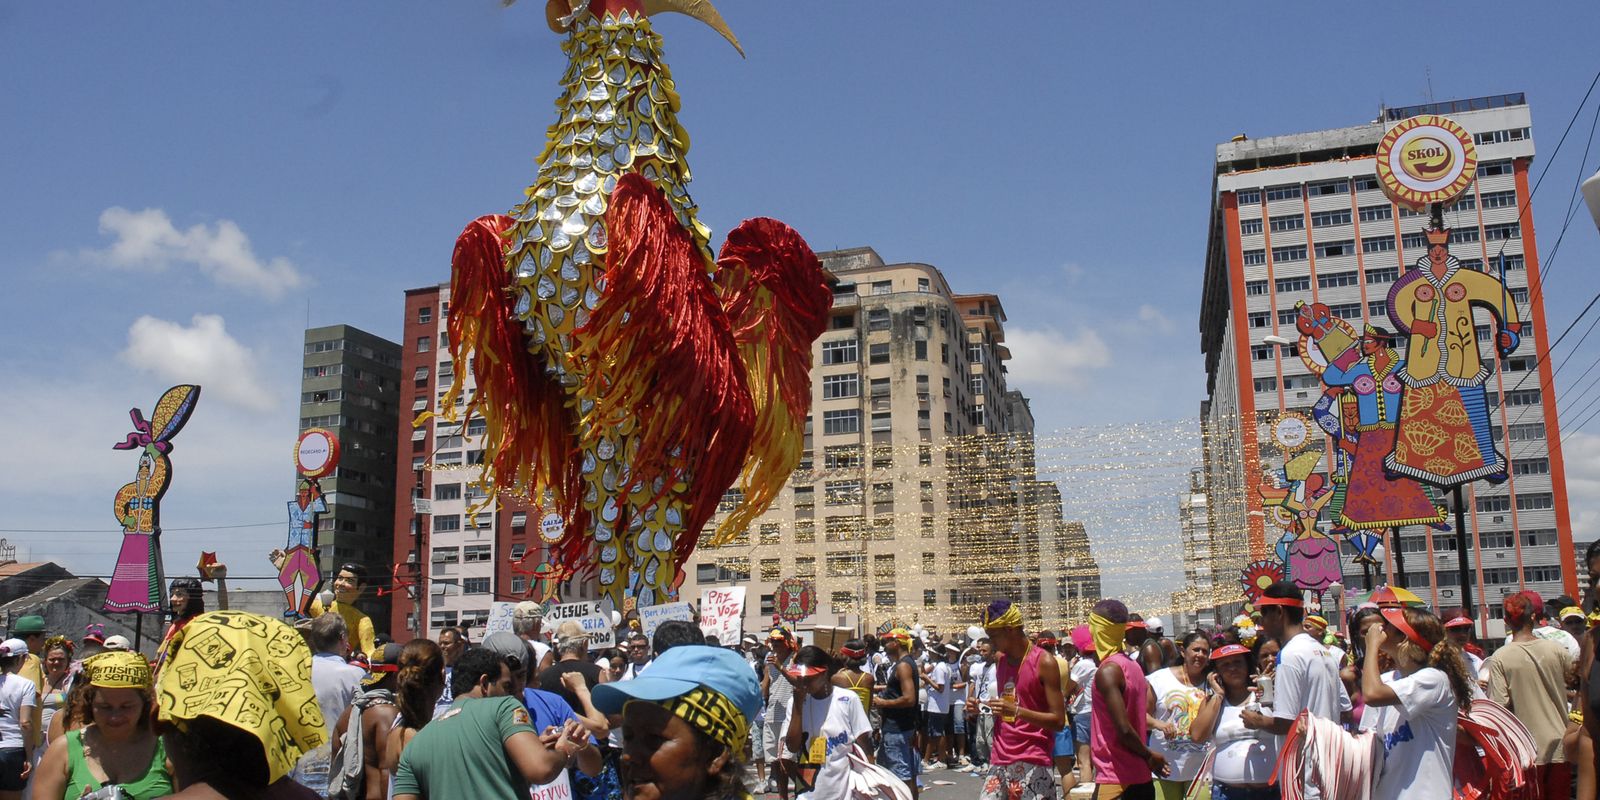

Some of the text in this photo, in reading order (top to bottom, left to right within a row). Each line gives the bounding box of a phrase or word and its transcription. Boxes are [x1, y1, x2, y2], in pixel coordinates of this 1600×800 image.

[1408, 147, 1444, 160] SKOL
[543, 518, 563, 527] CAIXA
[708, 590, 733, 604] PAZ
[553, 604, 589, 619] JESUS
[717, 603, 739, 618] VOZ
